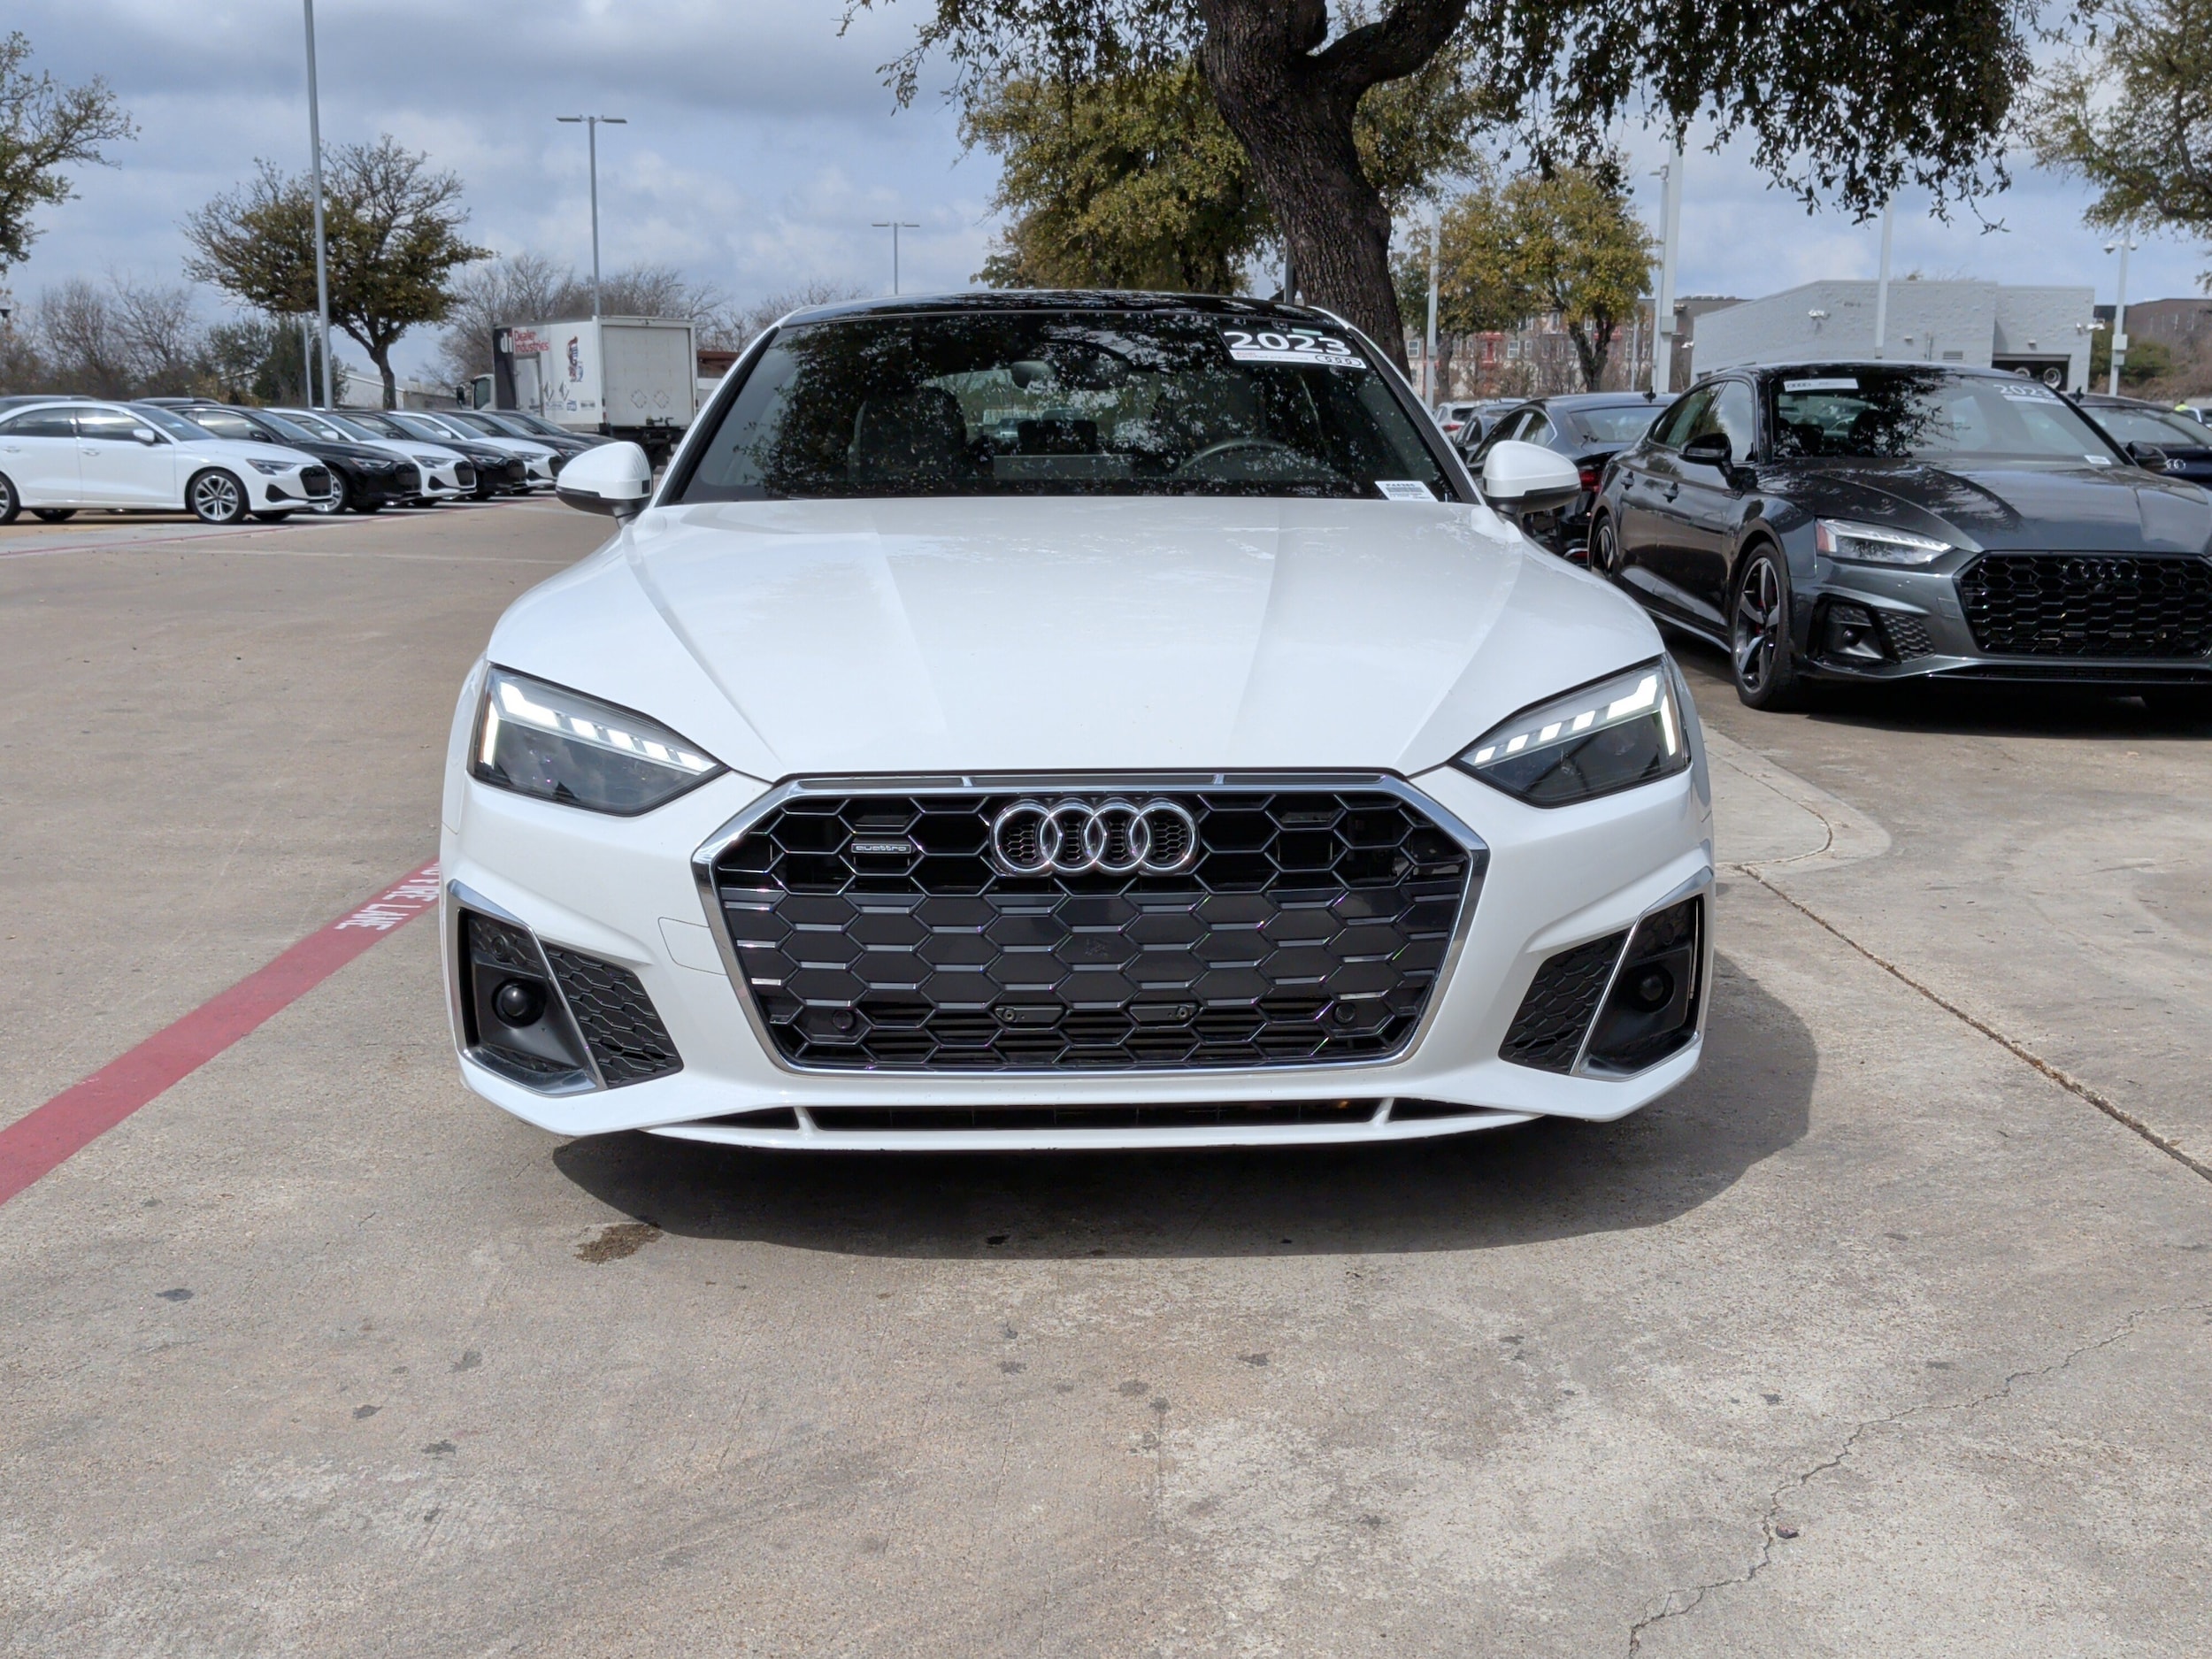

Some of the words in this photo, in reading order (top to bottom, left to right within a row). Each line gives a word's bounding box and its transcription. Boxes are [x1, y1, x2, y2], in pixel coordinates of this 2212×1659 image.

[514, 329, 537, 342] Dealer
[514, 340, 549, 352] Industries
[1224, 331, 1351, 356] 2023
[1993, 384, 2055, 398] 2023
[334, 903, 423, 930] LANE
